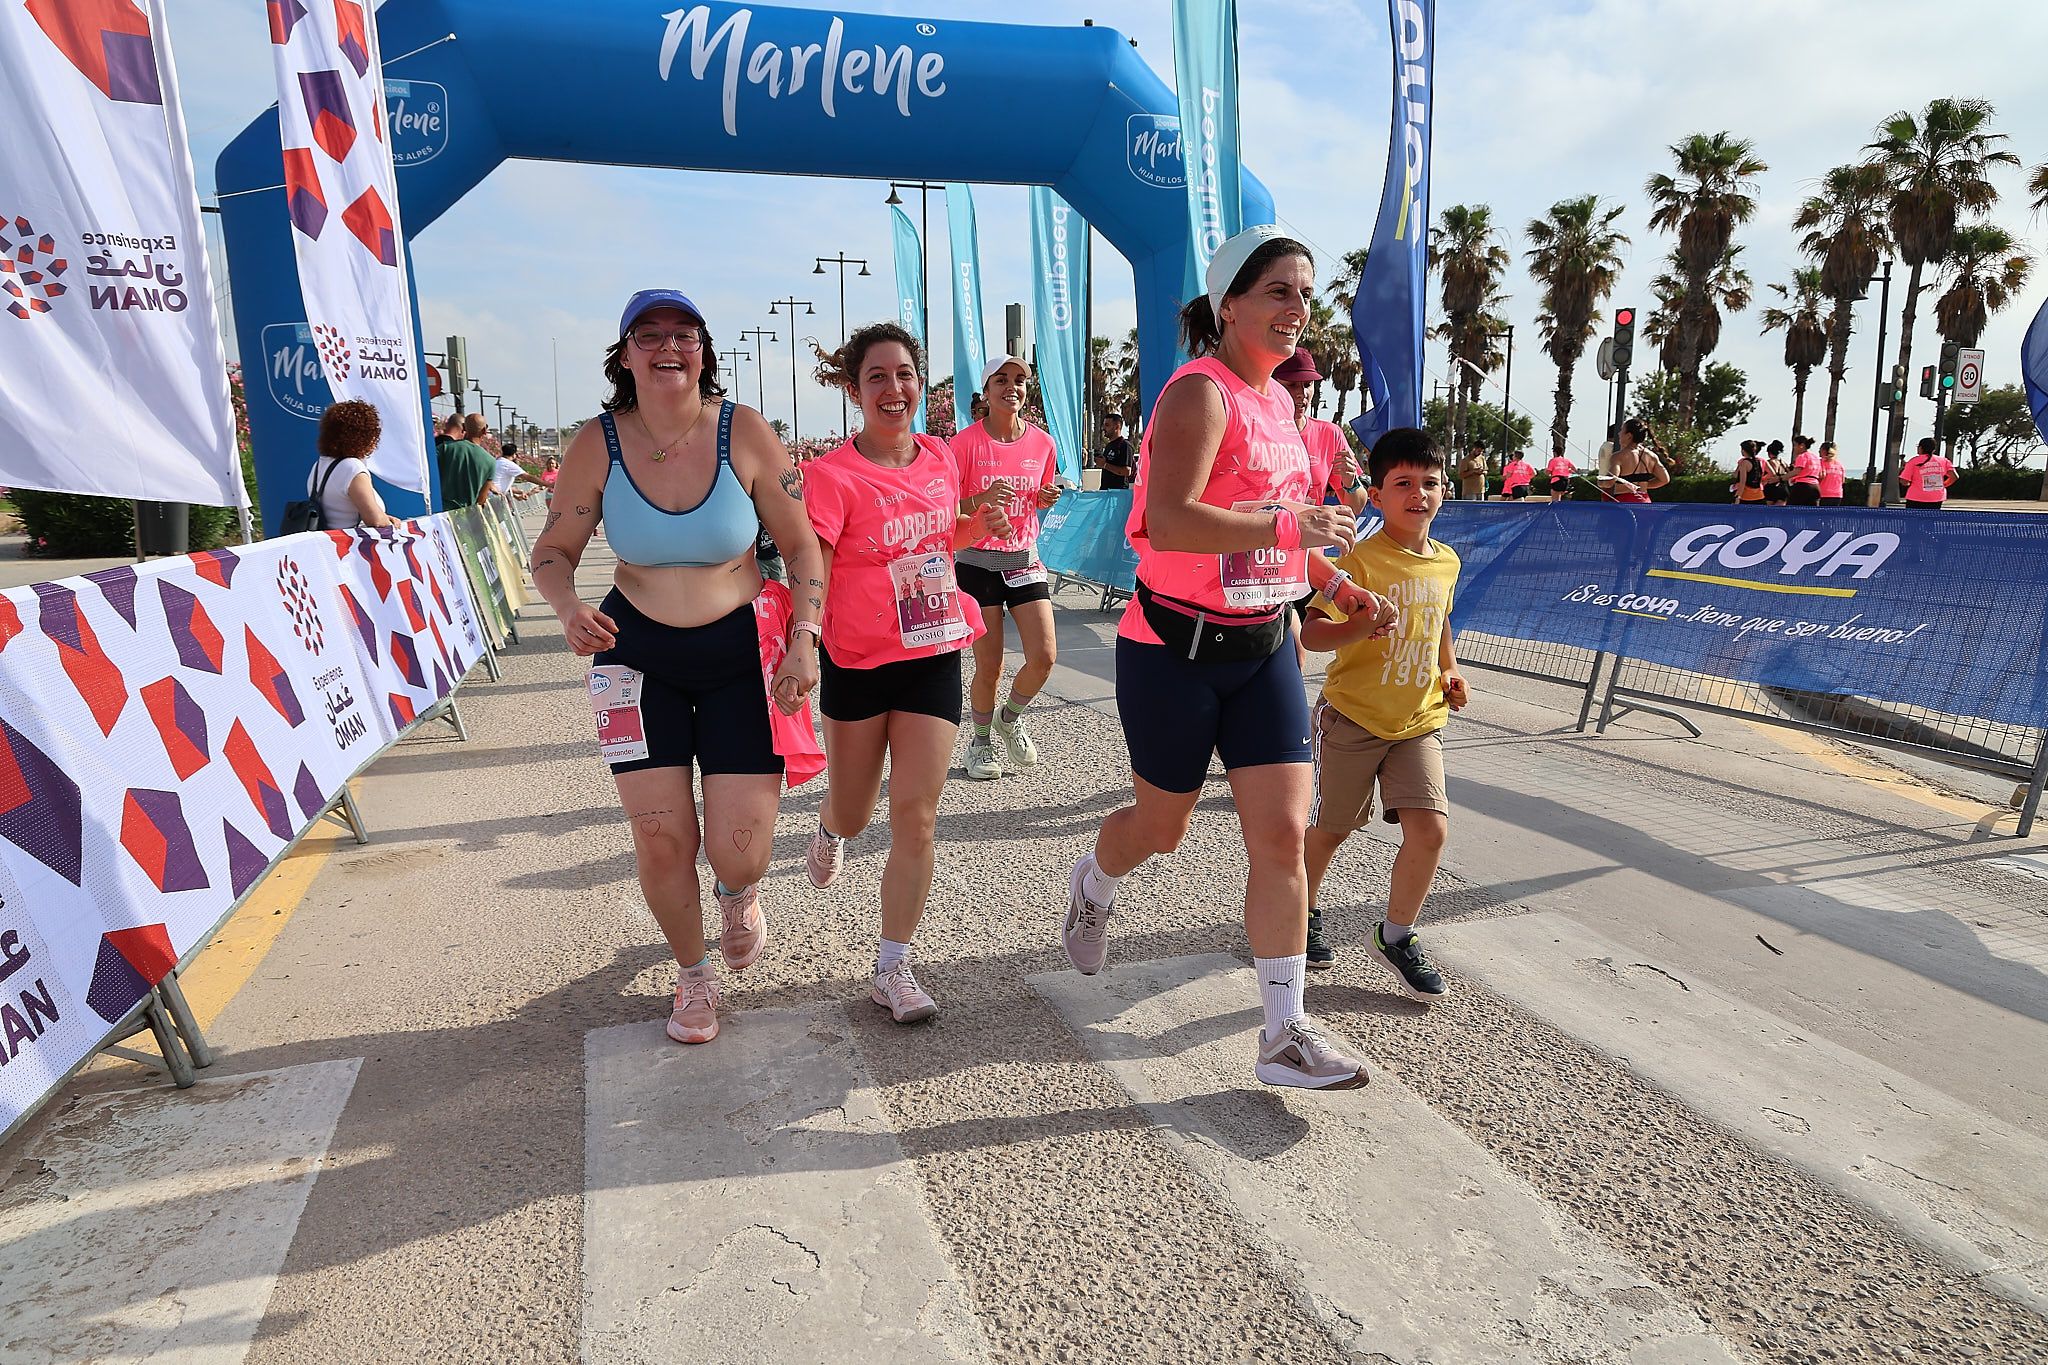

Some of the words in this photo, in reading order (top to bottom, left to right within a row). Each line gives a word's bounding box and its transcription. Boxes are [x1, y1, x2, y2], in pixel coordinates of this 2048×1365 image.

[658, 5, 946, 136] Marlene
[388, 98, 440, 137] rlene
[393, 153, 404, 161] OS
[406, 145, 433, 160] ALPES
[1134, 130, 1182, 169] Marl
[1138, 166, 1154, 180] HIJA
[1156, 175, 1166, 184] DE
[1168, 176, 1182, 184] LOS
[1964, 371, 1975, 381] 30
[282, 393, 305, 411] HIJA
[307, 404, 321, 413] DE
[720, 402, 733, 440] ARMOUR
[981, 475, 1035, 491] CARERA
[874, 490, 908, 508] OYSHO
[883, 506, 951, 547] CARRERA
[1254, 547, 1287, 565] 016
[1669, 524, 1900, 579] GOYA
[898, 563, 919, 574] SUMA
[1263, 567, 1279, 576] 2370
[1232, 590, 1262, 600] OYSHO
[1593, 594, 1618, 606] es
[1617, 593, 1679, 616] GOYA
[1732, 616, 1786, 642] que
[1784, 621, 1830, 637] ser
[1827, 613, 1929, 645] bueno!
[912, 630, 944, 643] OYSHO
[1381, 637, 1435, 666] JUNG
[312, 665, 344, 691] Experience
[1380, 659, 1432, 689] 196
[596, 710, 610, 728] 16
[334, 711, 367, 751] OMAN
[610, 735, 633, 744] VALENCIA
[606, 748, 634, 757] Santander
[0, 977, 60, 1067] AN
